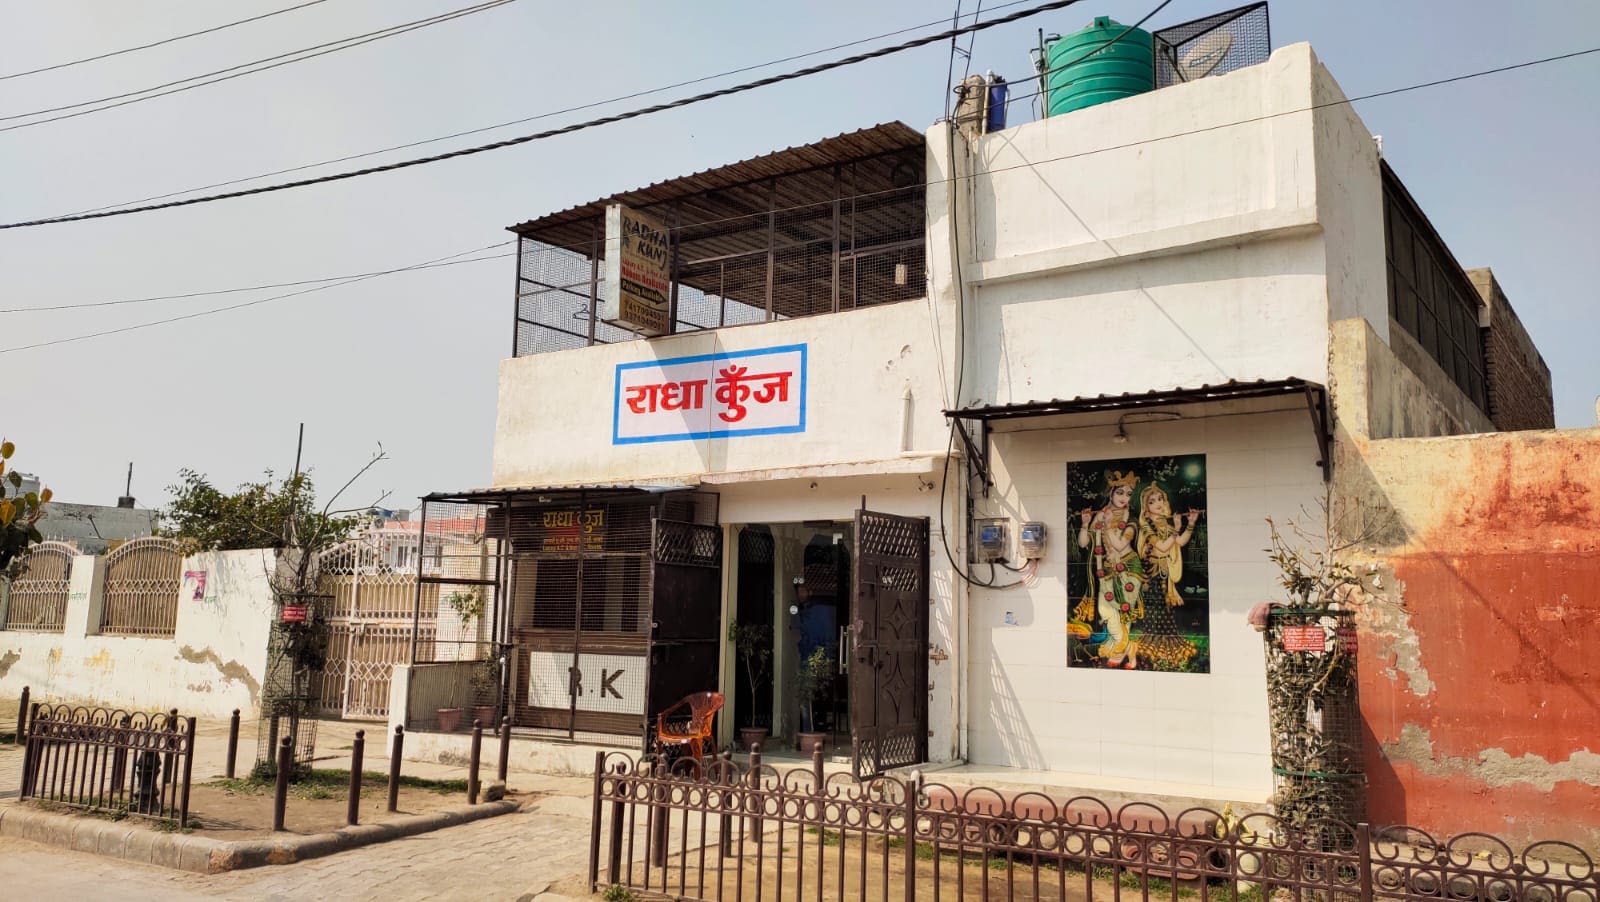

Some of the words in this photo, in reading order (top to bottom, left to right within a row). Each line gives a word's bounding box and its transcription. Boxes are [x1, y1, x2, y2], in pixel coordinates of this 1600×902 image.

[623, 215, 668, 250] RADHA
[637, 240, 667, 271] KUNJ
[626, 379, 707, 414] राधा
[715, 365, 792, 422] कुँज
[543, 511, 574, 528] राधा
